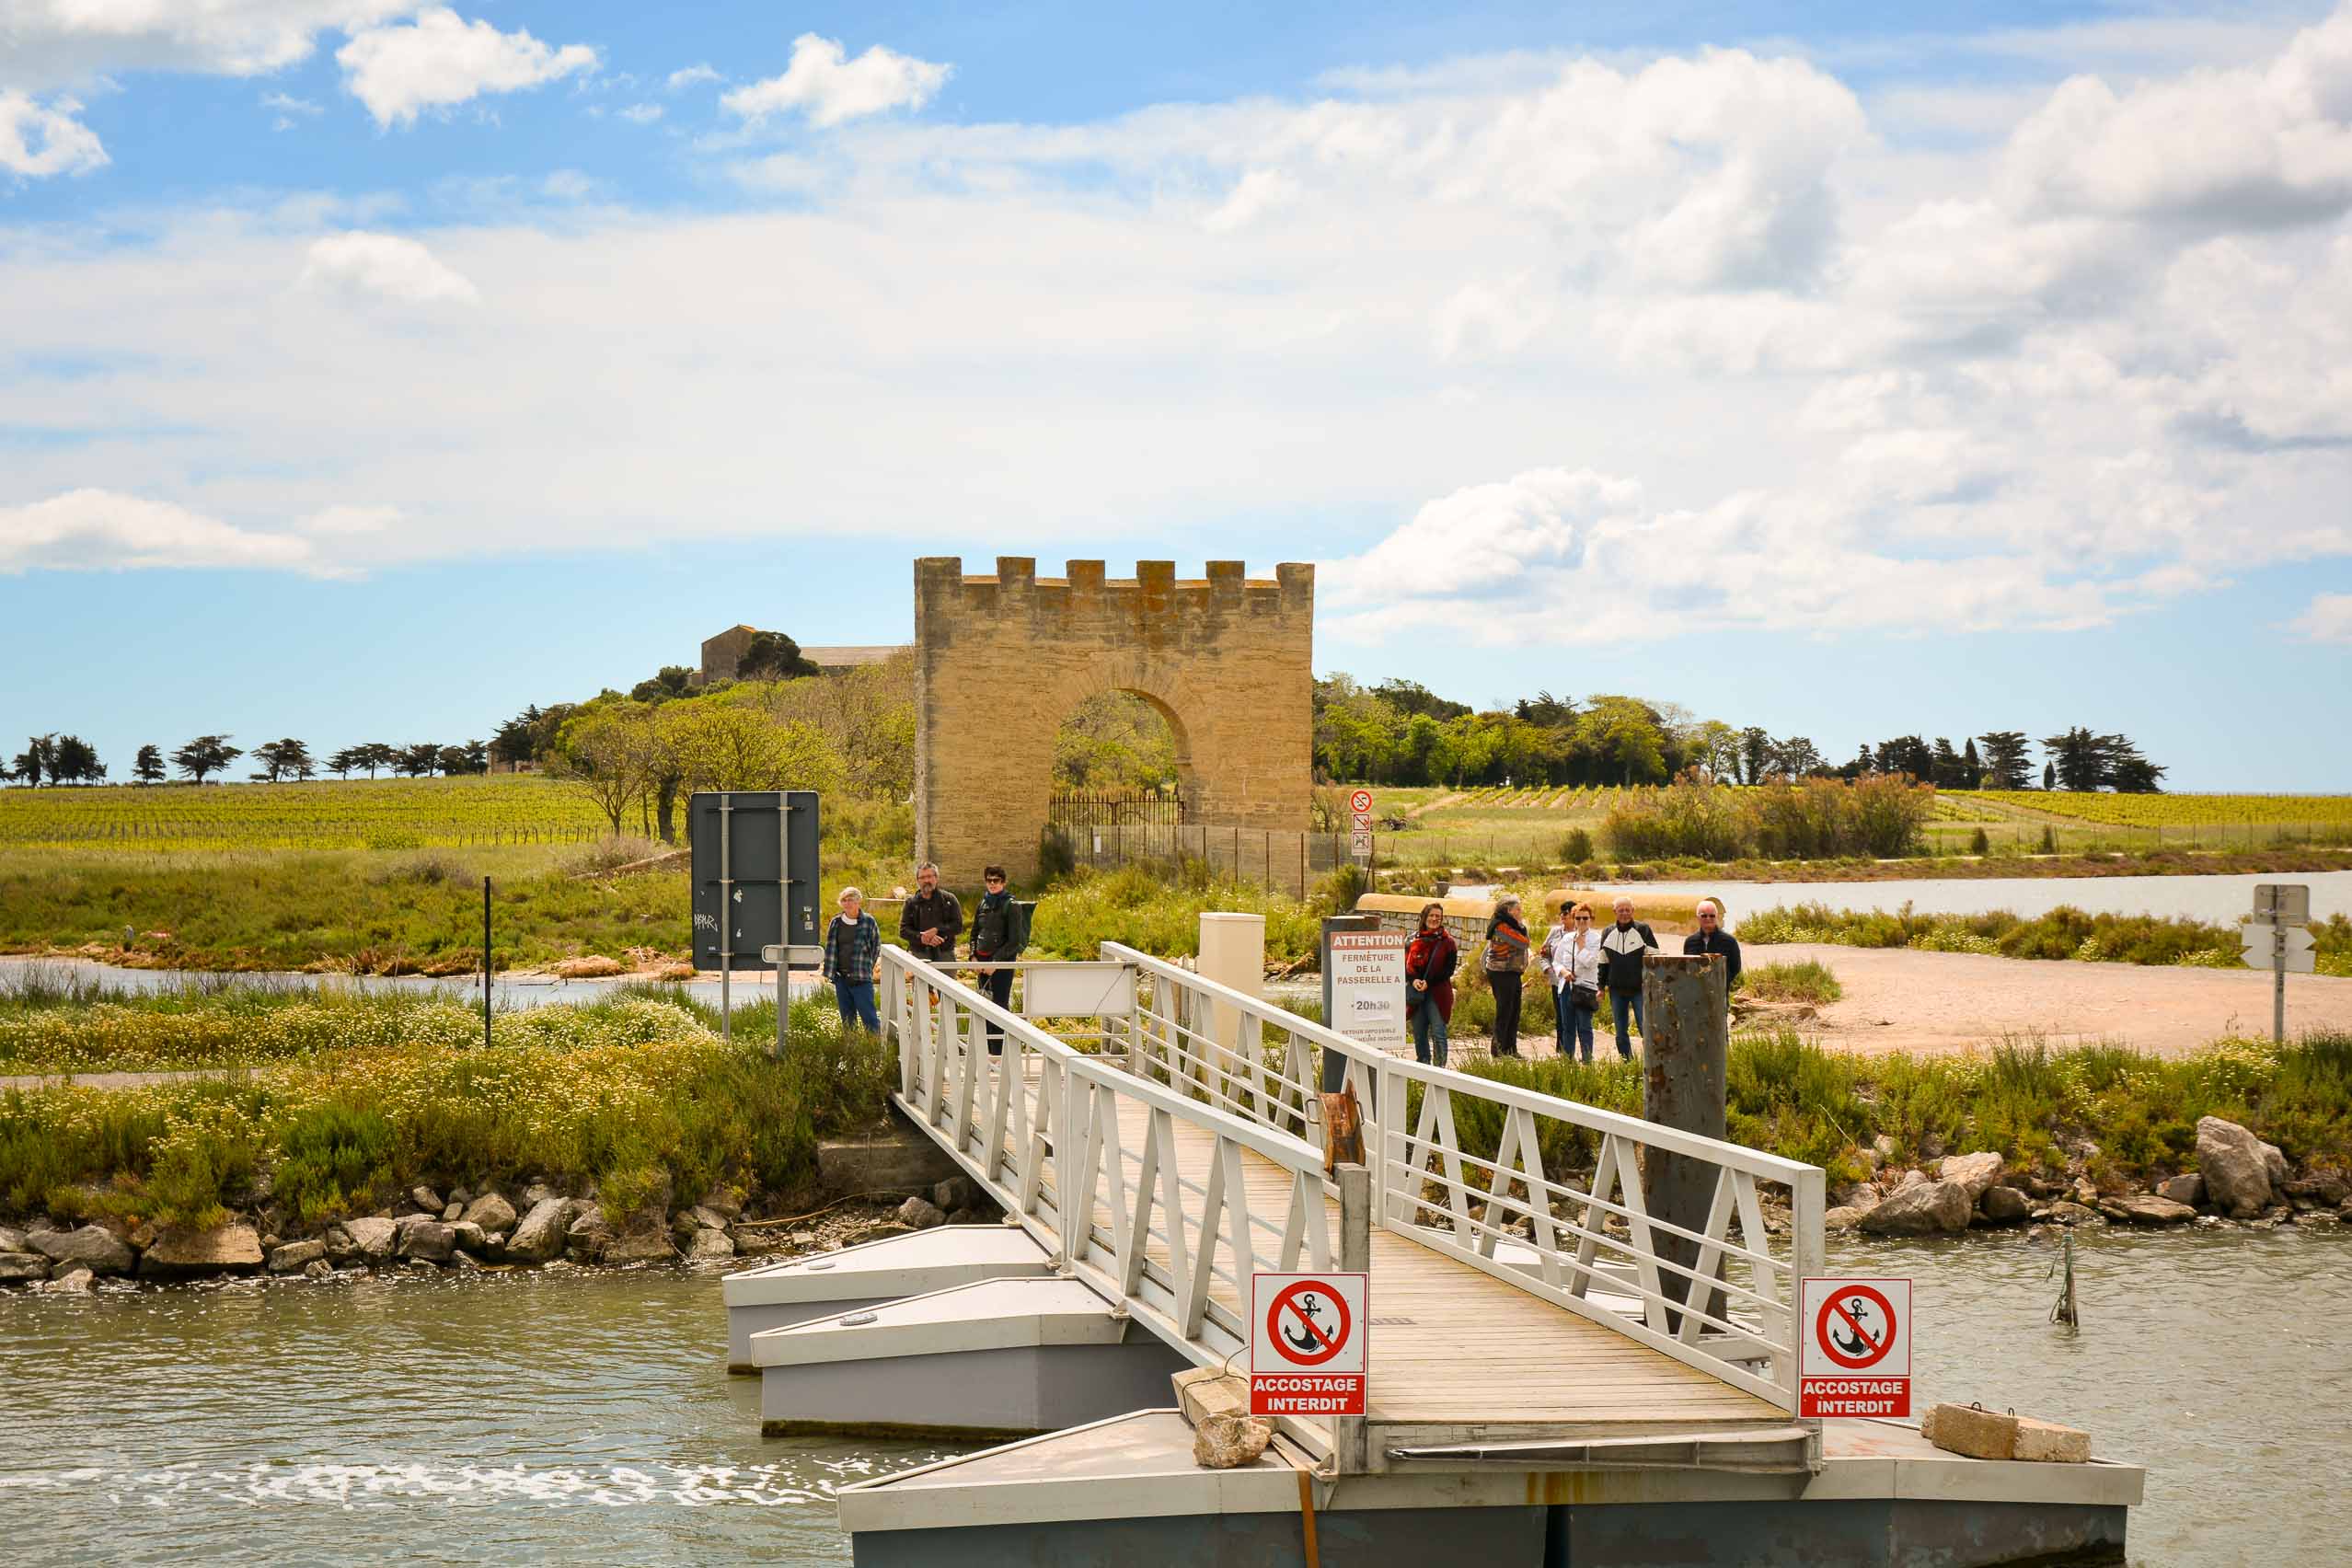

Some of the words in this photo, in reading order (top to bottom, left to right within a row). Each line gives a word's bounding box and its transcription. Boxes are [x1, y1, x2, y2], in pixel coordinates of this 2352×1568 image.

[1333, 935, 1403, 947] ATTENTION
[1342, 953, 1396, 963] FERMETURE
[1337, 976, 1392, 985] PASSERELLE
[1356, 1000, 1390, 1011] 20h30
[1253, 1378, 1357, 1391] ACCOSTAGE
[1804, 1381, 1903, 1395] ACCOSTAGE
[1267, 1398, 1348, 1411] INTERDIT
[1816, 1401, 1895, 1413] INTERDIT
